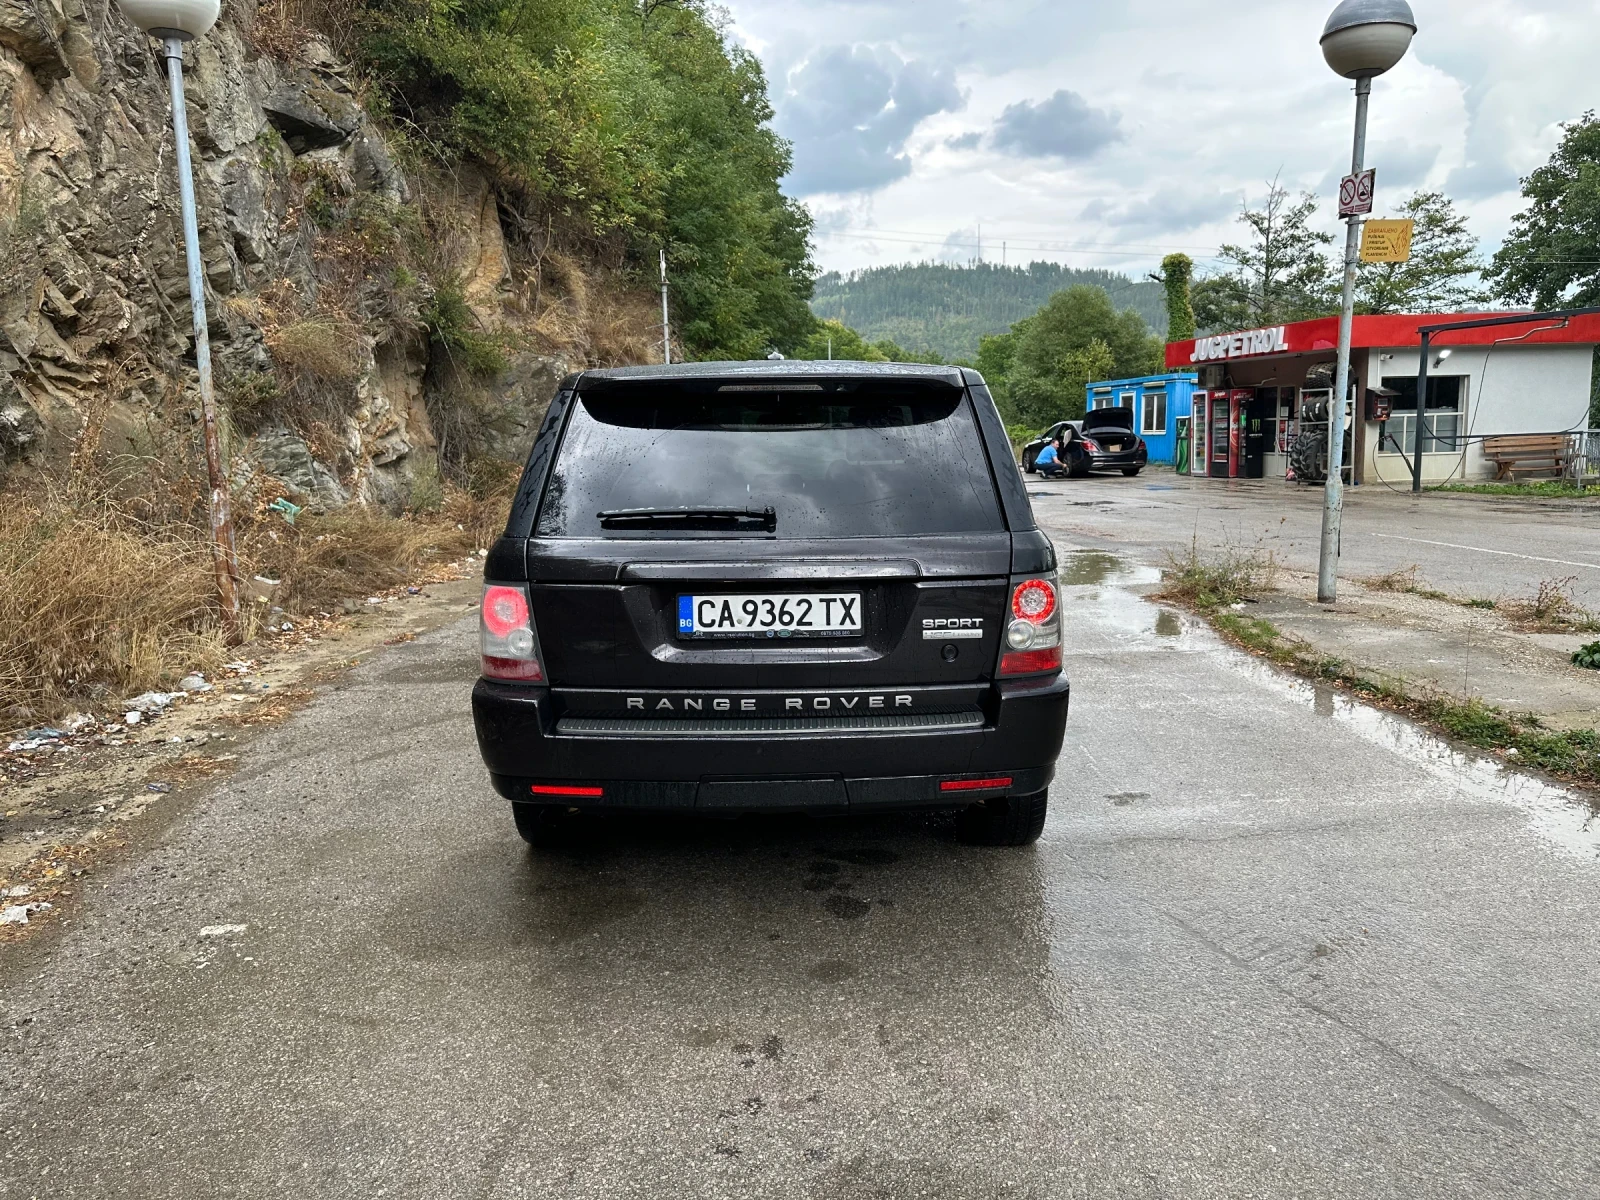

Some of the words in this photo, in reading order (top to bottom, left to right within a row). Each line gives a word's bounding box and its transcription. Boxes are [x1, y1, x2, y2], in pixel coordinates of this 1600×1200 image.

[1190, 326, 1288, 362] JUGPETROL
[679, 618, 692, 628] BG
[697, 599, 735, 628] CA
[741, 598, 813, 628] 9362
[819, 597, 857, 626] TX
[922, 618, 983, 628] SPORT
[626, 697, 756, 711] RANGE
[785, 695, 913, 710] ROVER
